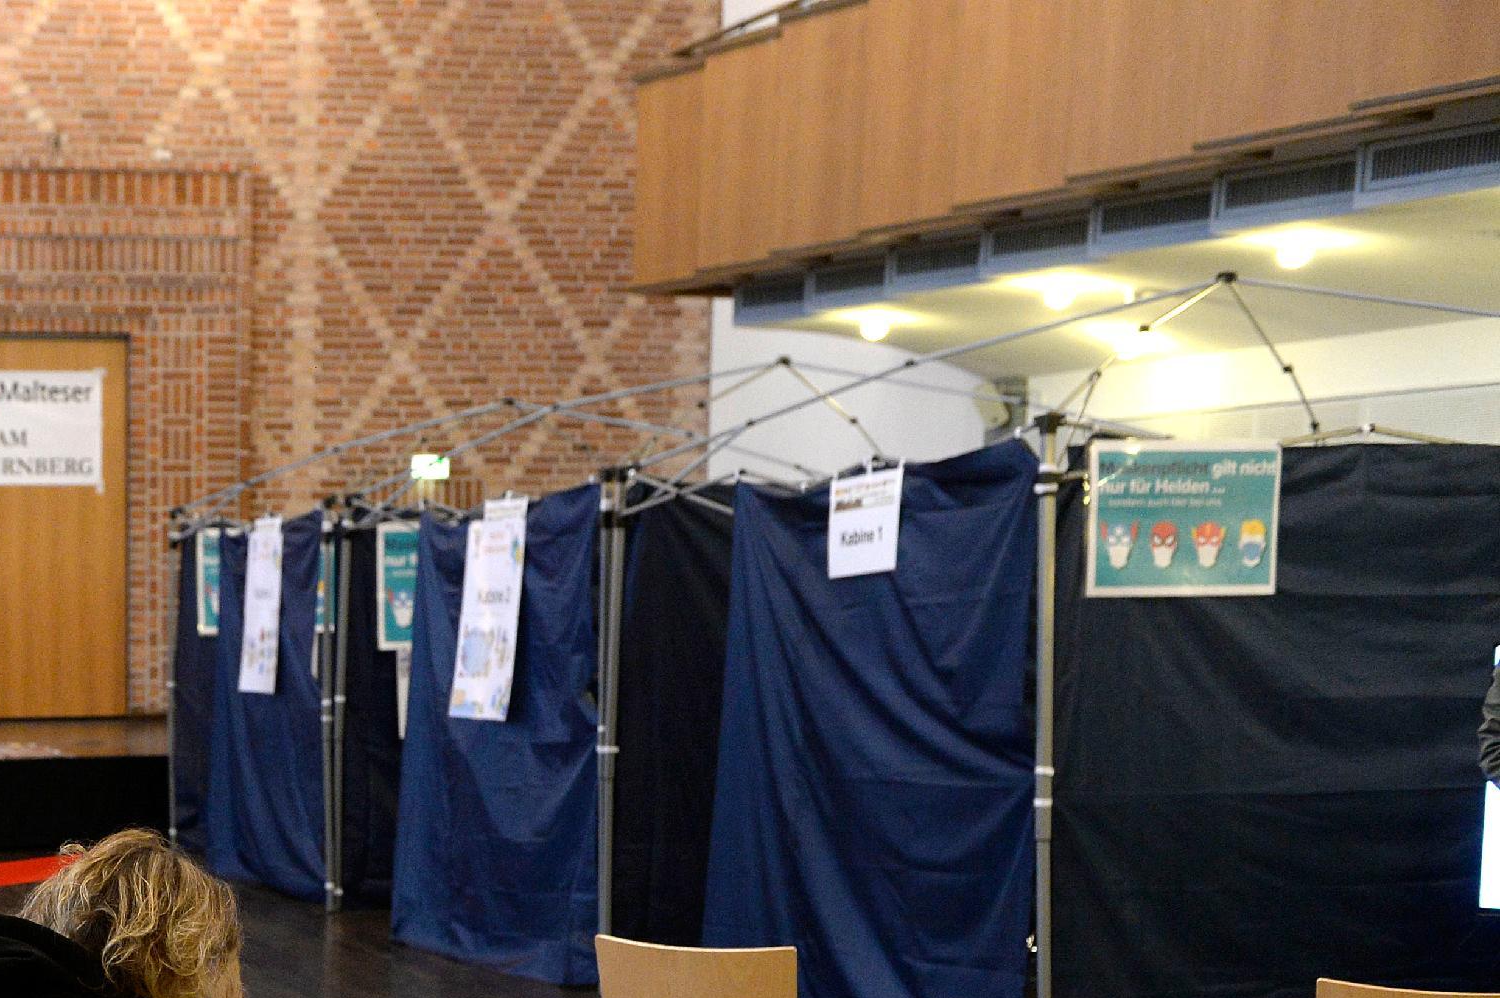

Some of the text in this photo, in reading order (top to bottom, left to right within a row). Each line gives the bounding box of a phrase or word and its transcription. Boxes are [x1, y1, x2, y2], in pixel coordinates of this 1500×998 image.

[1211, 458, 1237, 480] gilt
[1129, 477, 1150, 495] für
[1155, 478, 1211, 495] Helden
[840, 528, 875, 547] Kabine
